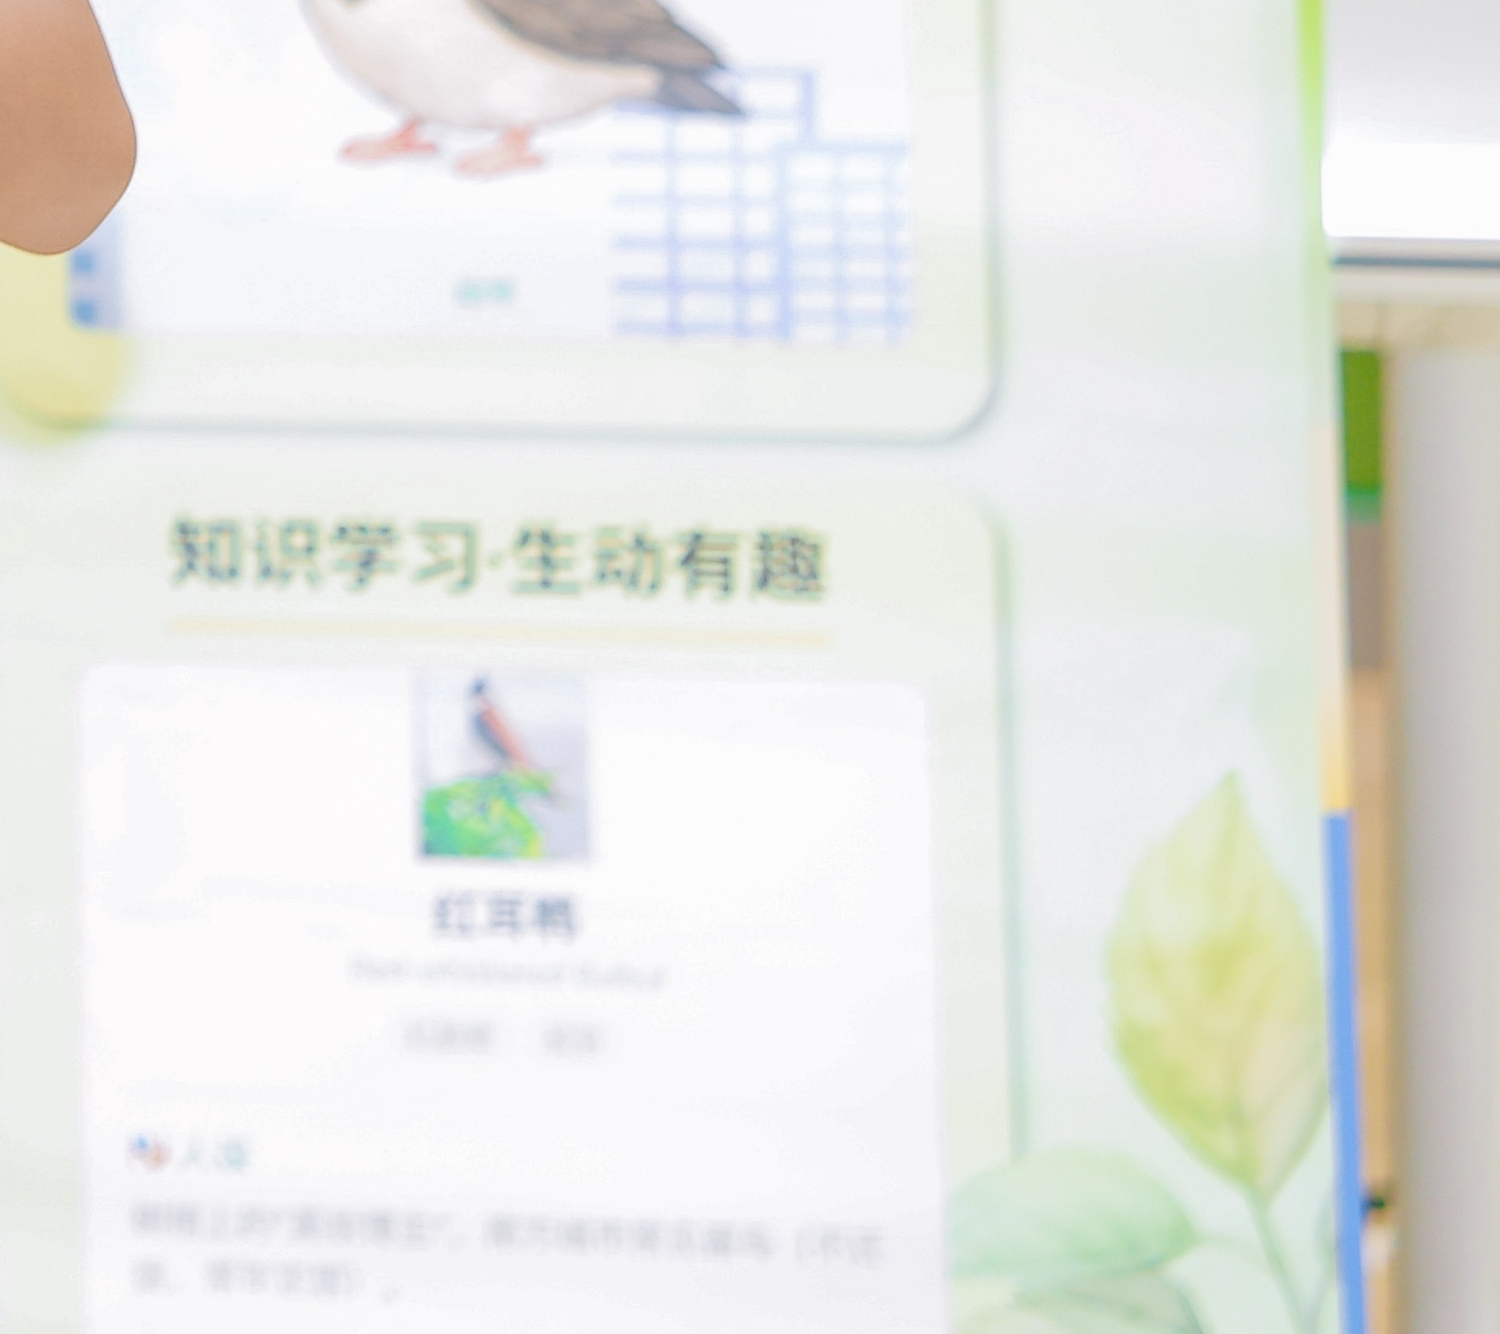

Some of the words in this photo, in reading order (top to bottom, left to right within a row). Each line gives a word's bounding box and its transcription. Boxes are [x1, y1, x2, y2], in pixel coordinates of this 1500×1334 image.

[169, 514, 829, 602] 知识学习·生动有趣
